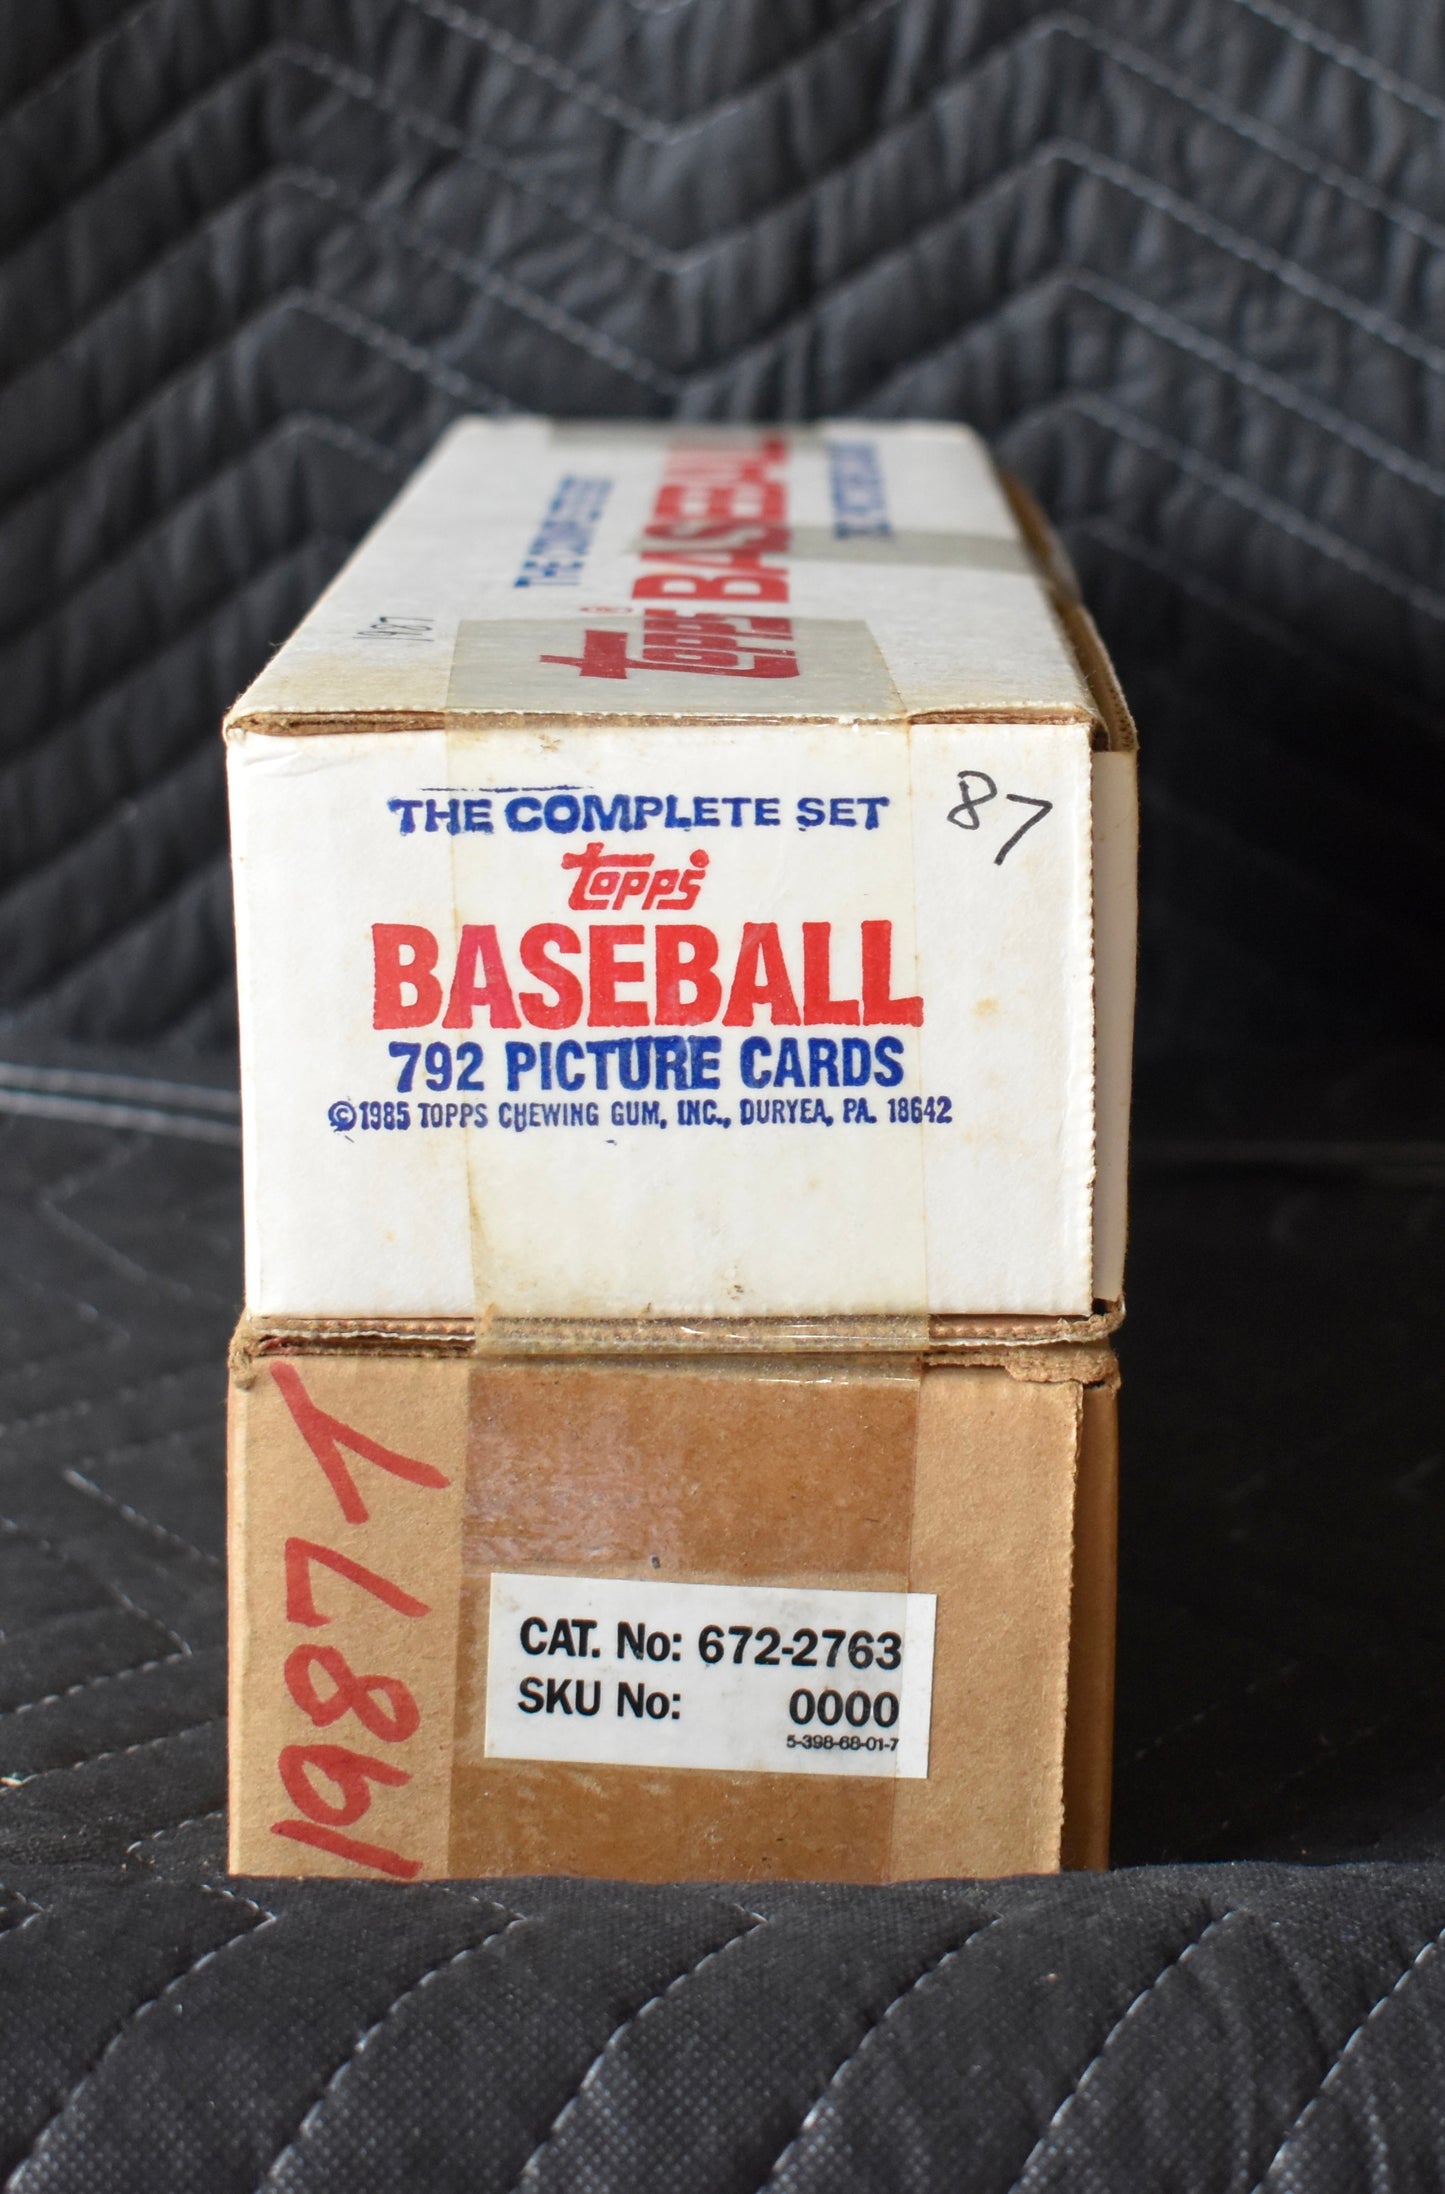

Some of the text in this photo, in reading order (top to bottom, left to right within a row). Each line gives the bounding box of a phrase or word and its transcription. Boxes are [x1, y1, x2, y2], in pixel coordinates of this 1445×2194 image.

[388, 794, 890, 834] THE COMPLETE SET
[947, 769, 1053, 865] 87
[372, 920, 924, 1030] BASEBALL
[388, 1035, 905, 1092] 792 PICTURE CARDS
[417, 1102, 488, 1129] TOPPS
[498, 1101, 599, 1132] CHEWING
[611, 1100, 667, 1129] GUM,
[677, 1099, 731, 1129] INC.,
[740, 1098, 834, 1127] DURYEA,
[842, 1097, 877, 1124] PA.
[887, 1095, 952, 1124] 18642
[519, 1617, 902, 1670] CAT. No: 672-2763
[269, 1538, 432, 1880] 1987
[517, 1676, 899, 1727] SKU No: 0000
[786, 1734, 899, 1752] 5-398-68-01-7
